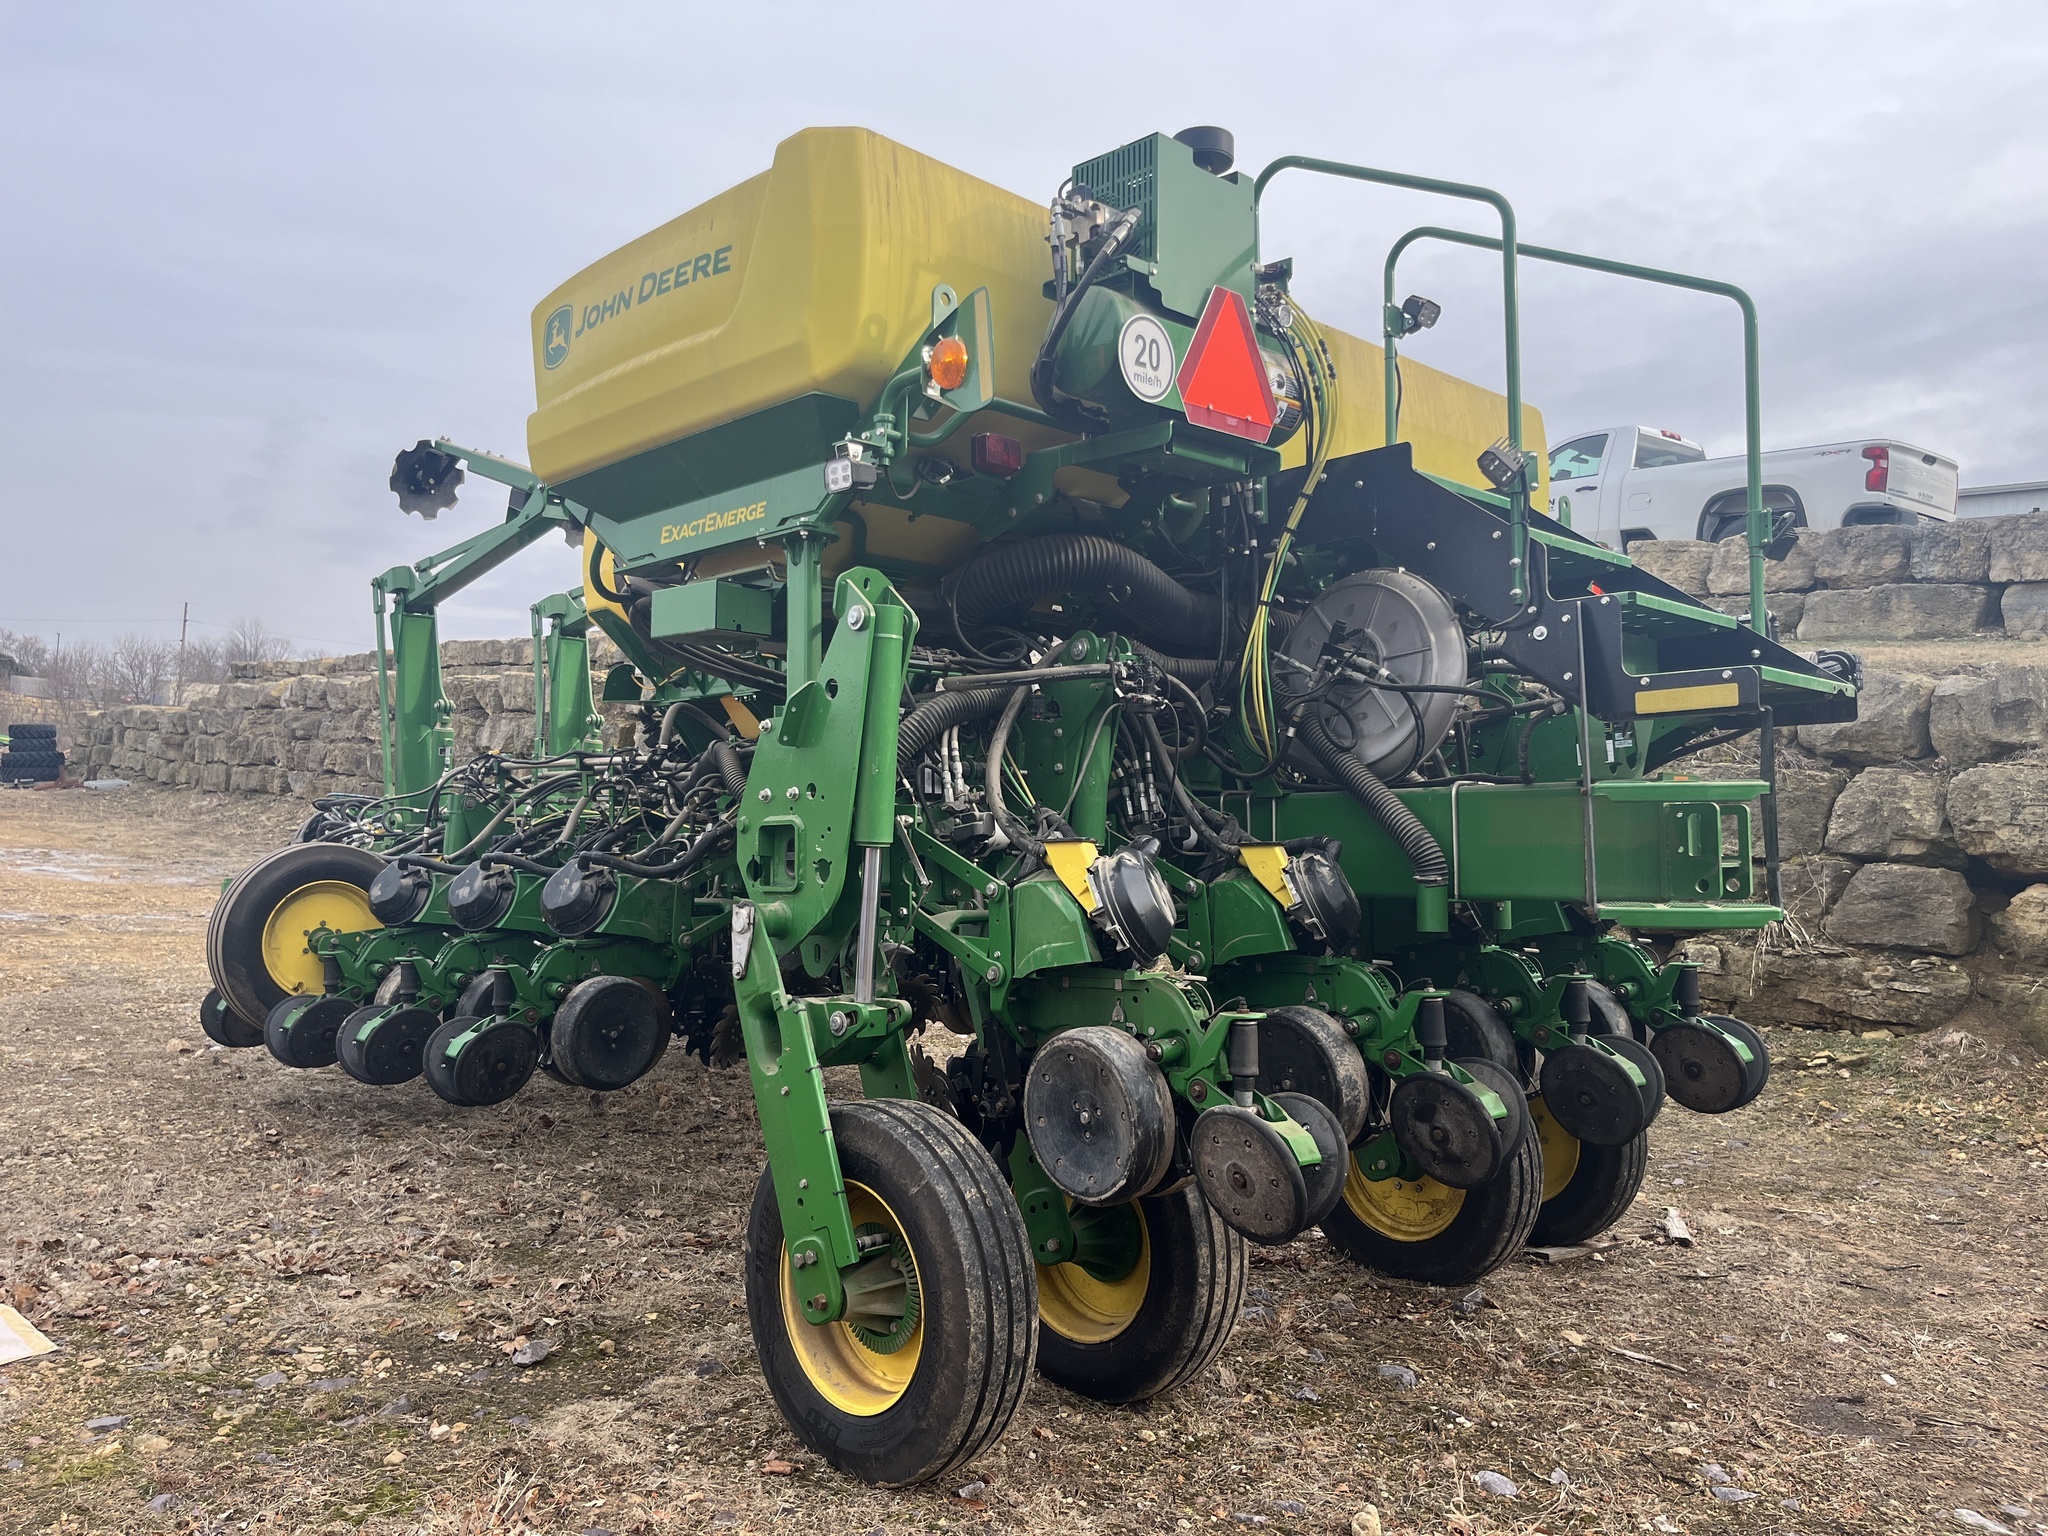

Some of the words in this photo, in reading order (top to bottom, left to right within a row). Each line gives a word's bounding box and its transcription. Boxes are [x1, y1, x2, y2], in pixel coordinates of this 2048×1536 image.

[575, 286, 634, 338] JOHN
[638, 245, 732, 305] DEERE
[1134, 334, 1160, 372] 20
[1133, 371, 1162, 389] mile/h
